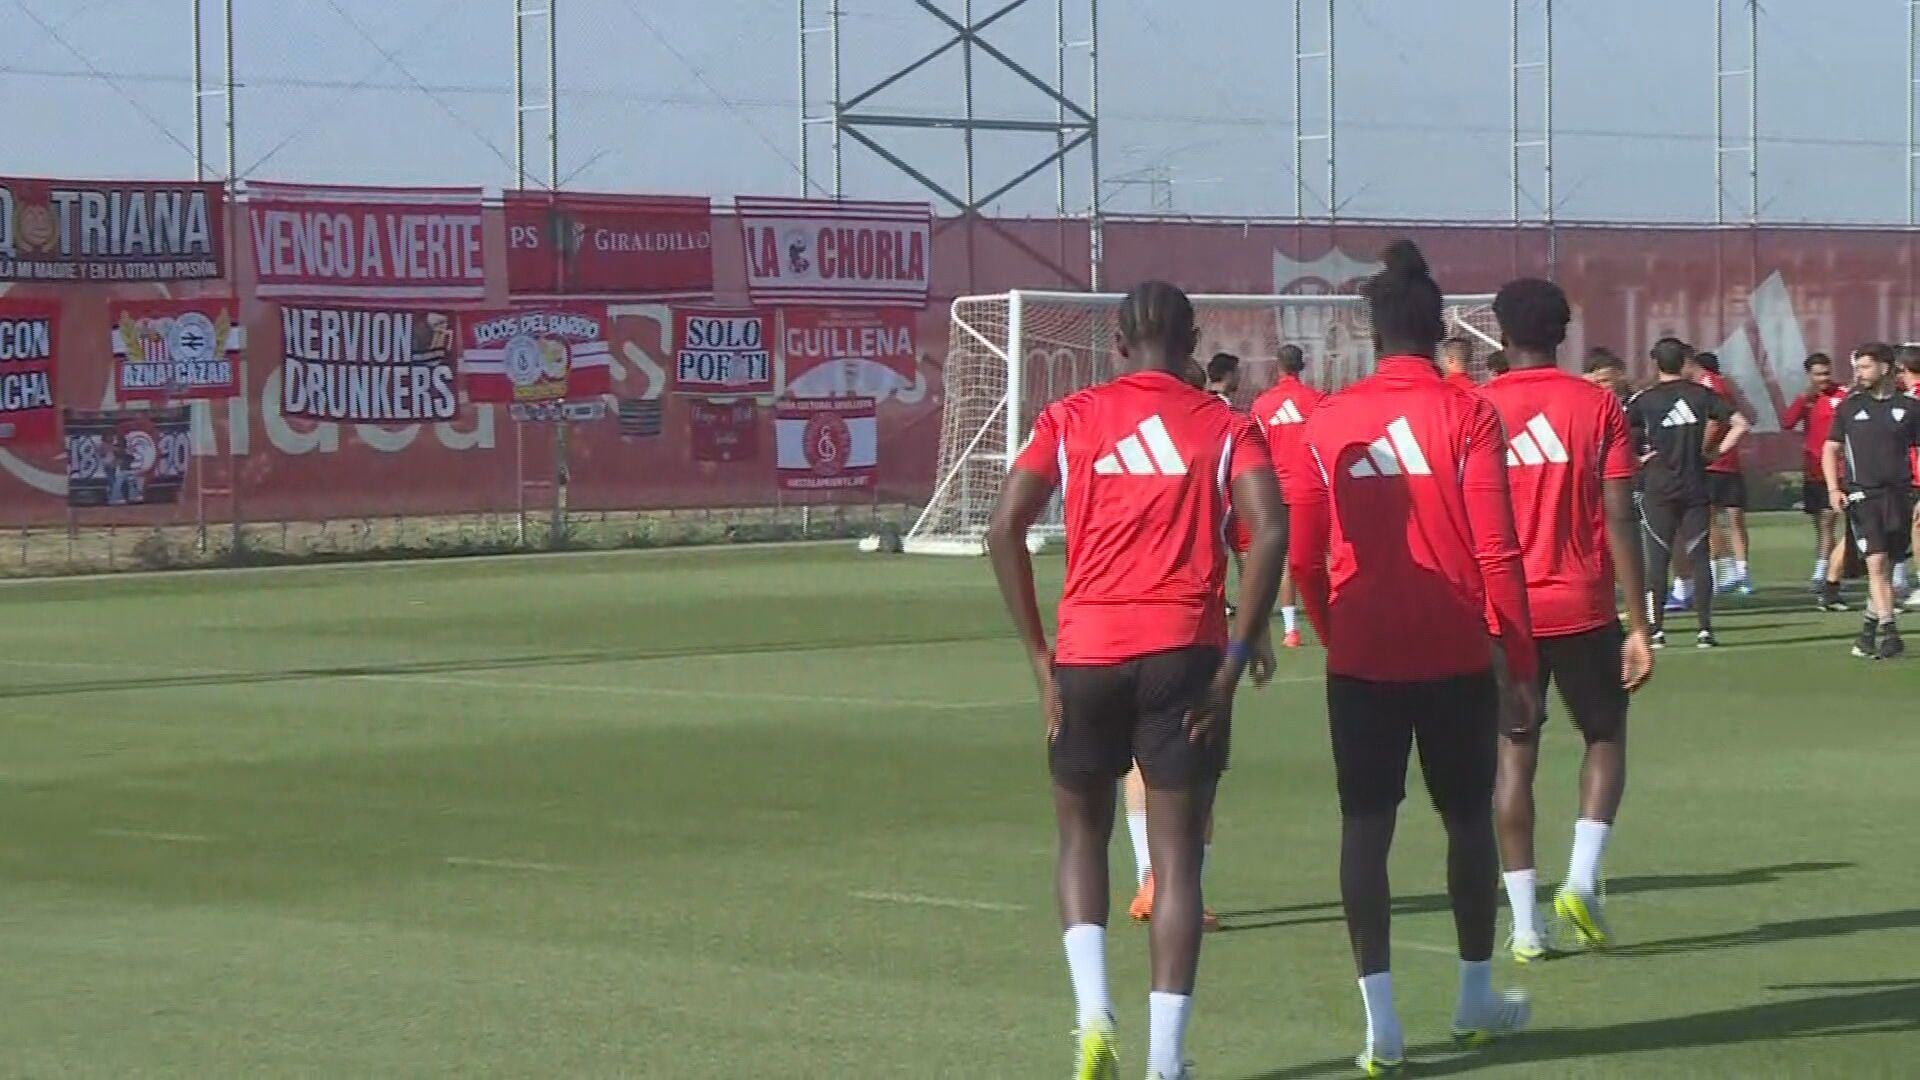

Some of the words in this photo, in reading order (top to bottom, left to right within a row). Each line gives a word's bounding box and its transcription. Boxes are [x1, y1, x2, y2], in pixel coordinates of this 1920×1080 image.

[51, 191, 211, 255] TRIANA
[511, 226, 538, 249] PS
[595, 229, 710, 250] GIRALDILLO
[251, 210, 355, 277] VENGO
[361, 214, 385, 277] A
[387, 214, 483, 278] VERTE
[747, 226, 780, 277] LA
[816, 227, 925, 281] CHORLA
[79, 262, 87, 278] Y
[89, 262, 106, 278] EN
[108, 262, 123, 278] LA
[126, 262, 156, 278] OTRA
[158, 262, 173, 278] MI
[281, 306, 413, 362] NERVION
[474, 319, 518, 341] LOCOS
[520, 315, 544, 333] DEL
[548, 315, 599, 339] BARRIO
[689, 319, 760, 346] SOLO
[786, 327, 913, 358] GUILLENA
[679, 354, 731, 381] POR
[744, 353, 767, 379] TI
[0, 371, 51, 411] CHA
[285, 358, 456, 419] DRUNKERS
